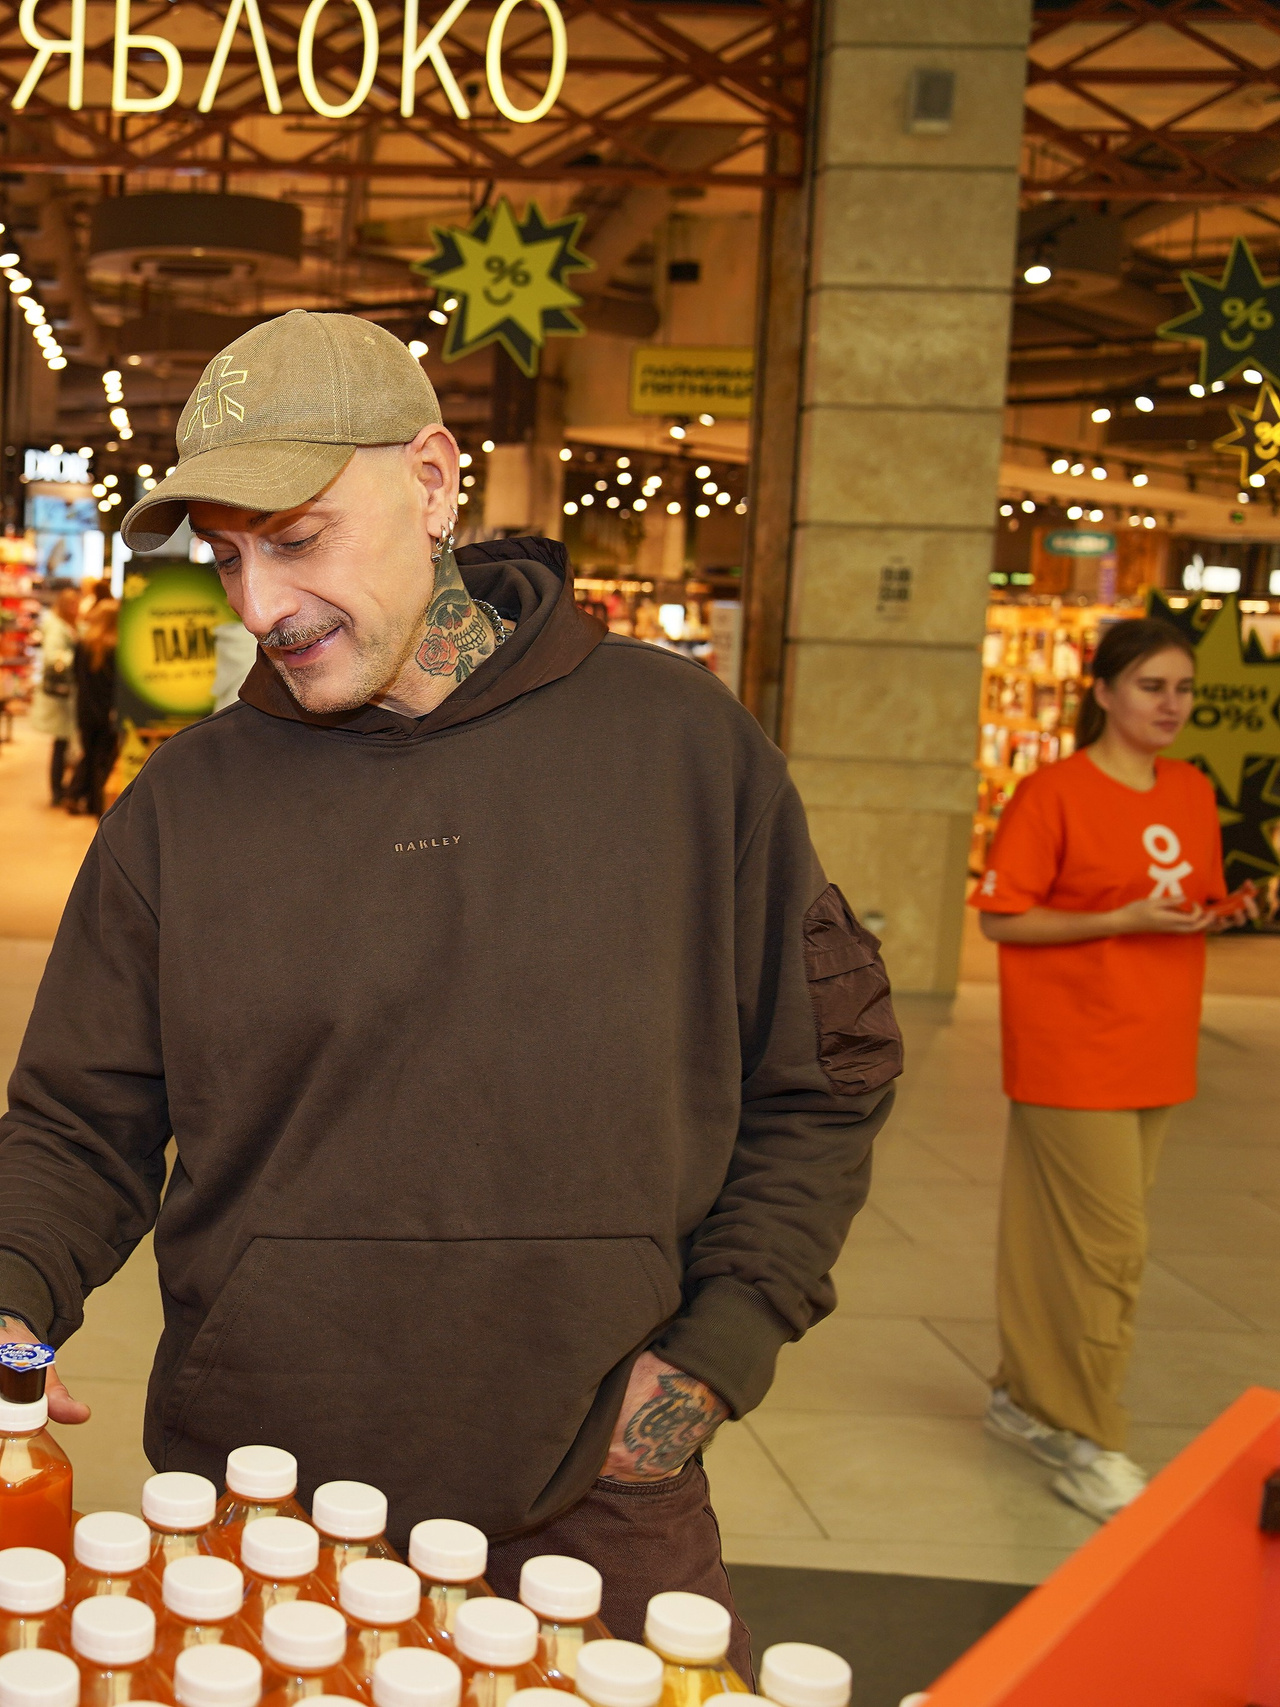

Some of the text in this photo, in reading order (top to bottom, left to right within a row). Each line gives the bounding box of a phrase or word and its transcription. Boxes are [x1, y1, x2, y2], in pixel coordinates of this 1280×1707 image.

[11, 0, 568, 123] ЯБЛОКО
[1191, 704, 1265, 733] 0%
[394, 835, 461, 852] OAKLEY
